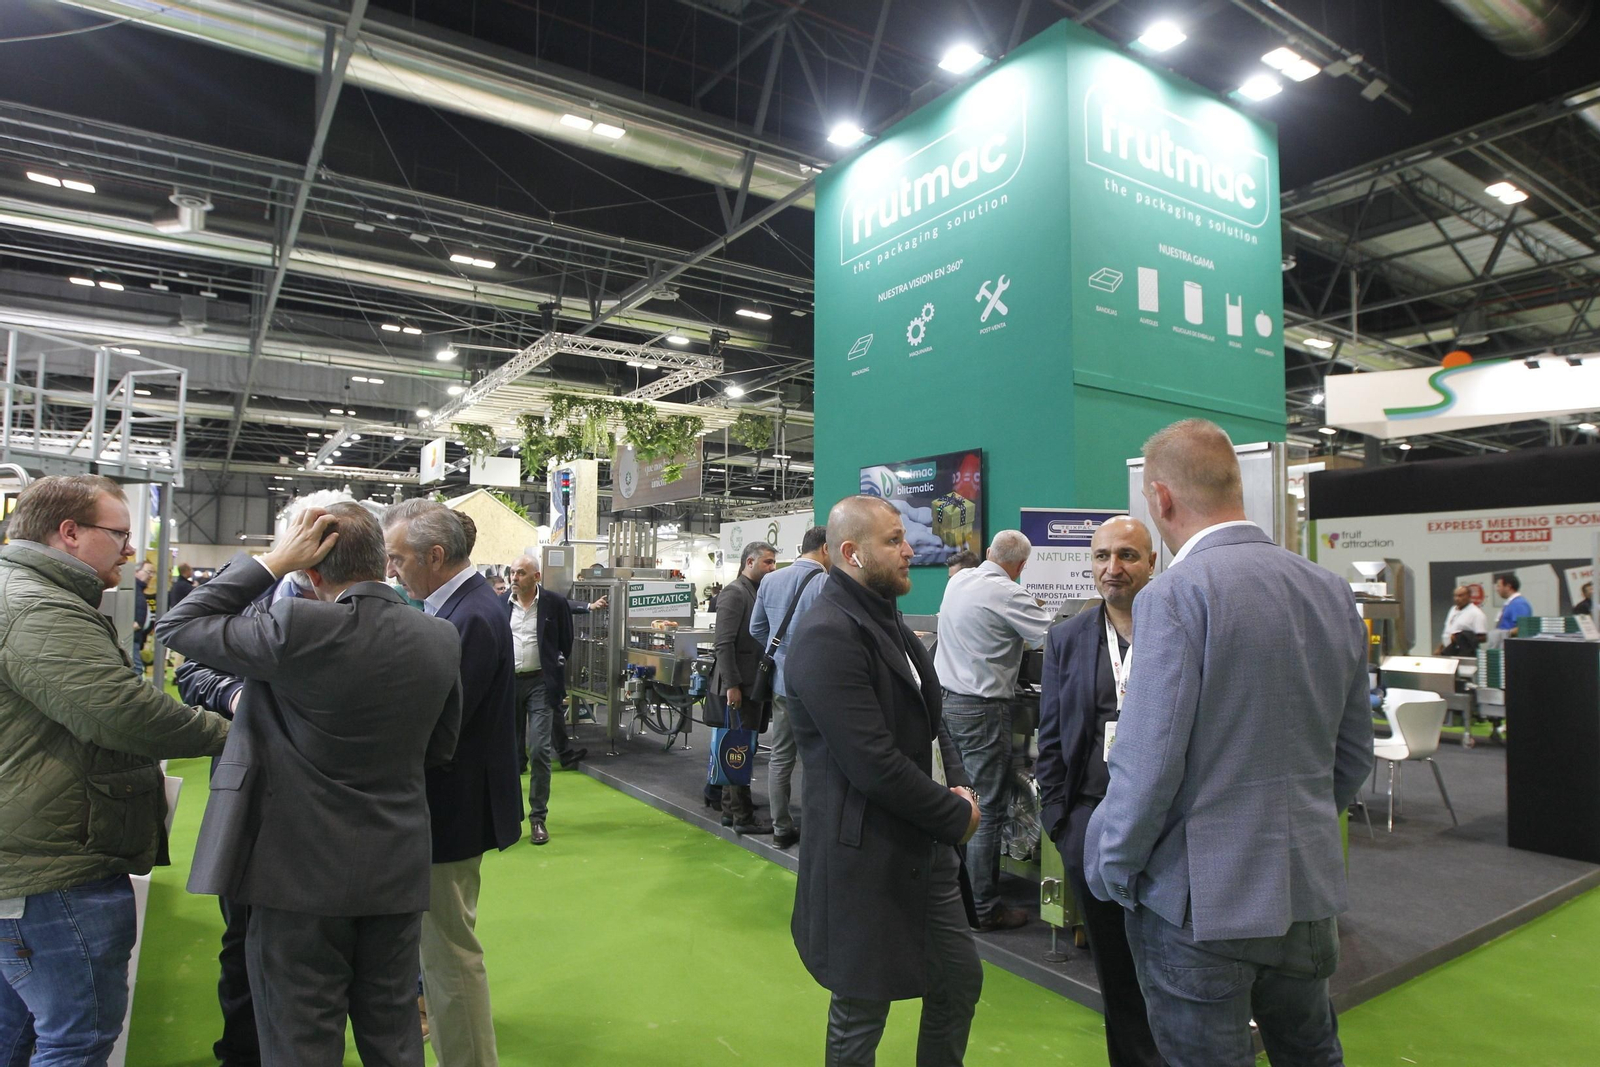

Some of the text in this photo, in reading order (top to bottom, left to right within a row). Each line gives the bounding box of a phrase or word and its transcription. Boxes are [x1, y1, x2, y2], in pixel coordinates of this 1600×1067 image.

[1104, 177, 1258, 245] the packaging solution
[853, 194, 1009, 275] the packaging solution
[1159, 243, 1216, 271] NUESTRA GAMA
[877, 283, 909, 303] NUESTRA
[908, 272, 934, 289] VISION
[934, 266, 945, 279] EN
[979, 322, 1007, 335] POST-VENTA
[908, 346, 934, 358] MAQUINARIA
[896, 482, 934, 495] blitzmatic
[1427, 519, 1483, 532] EXPRESS
[1487, 516, 1550, 529] MEETING
[1341, 530, 1362, 540] fruit
[1484, 530, 1549, 542] FOR RENT
[1341, 539, 1394, 549] attraction
[1037, 552, 1082, 562] NATURE
[1026, 583, 1054, 591] PRIMER
[1055, 583, 1074, 591] FILM
[632, 593, 689, 606] BLITZMATIC+
